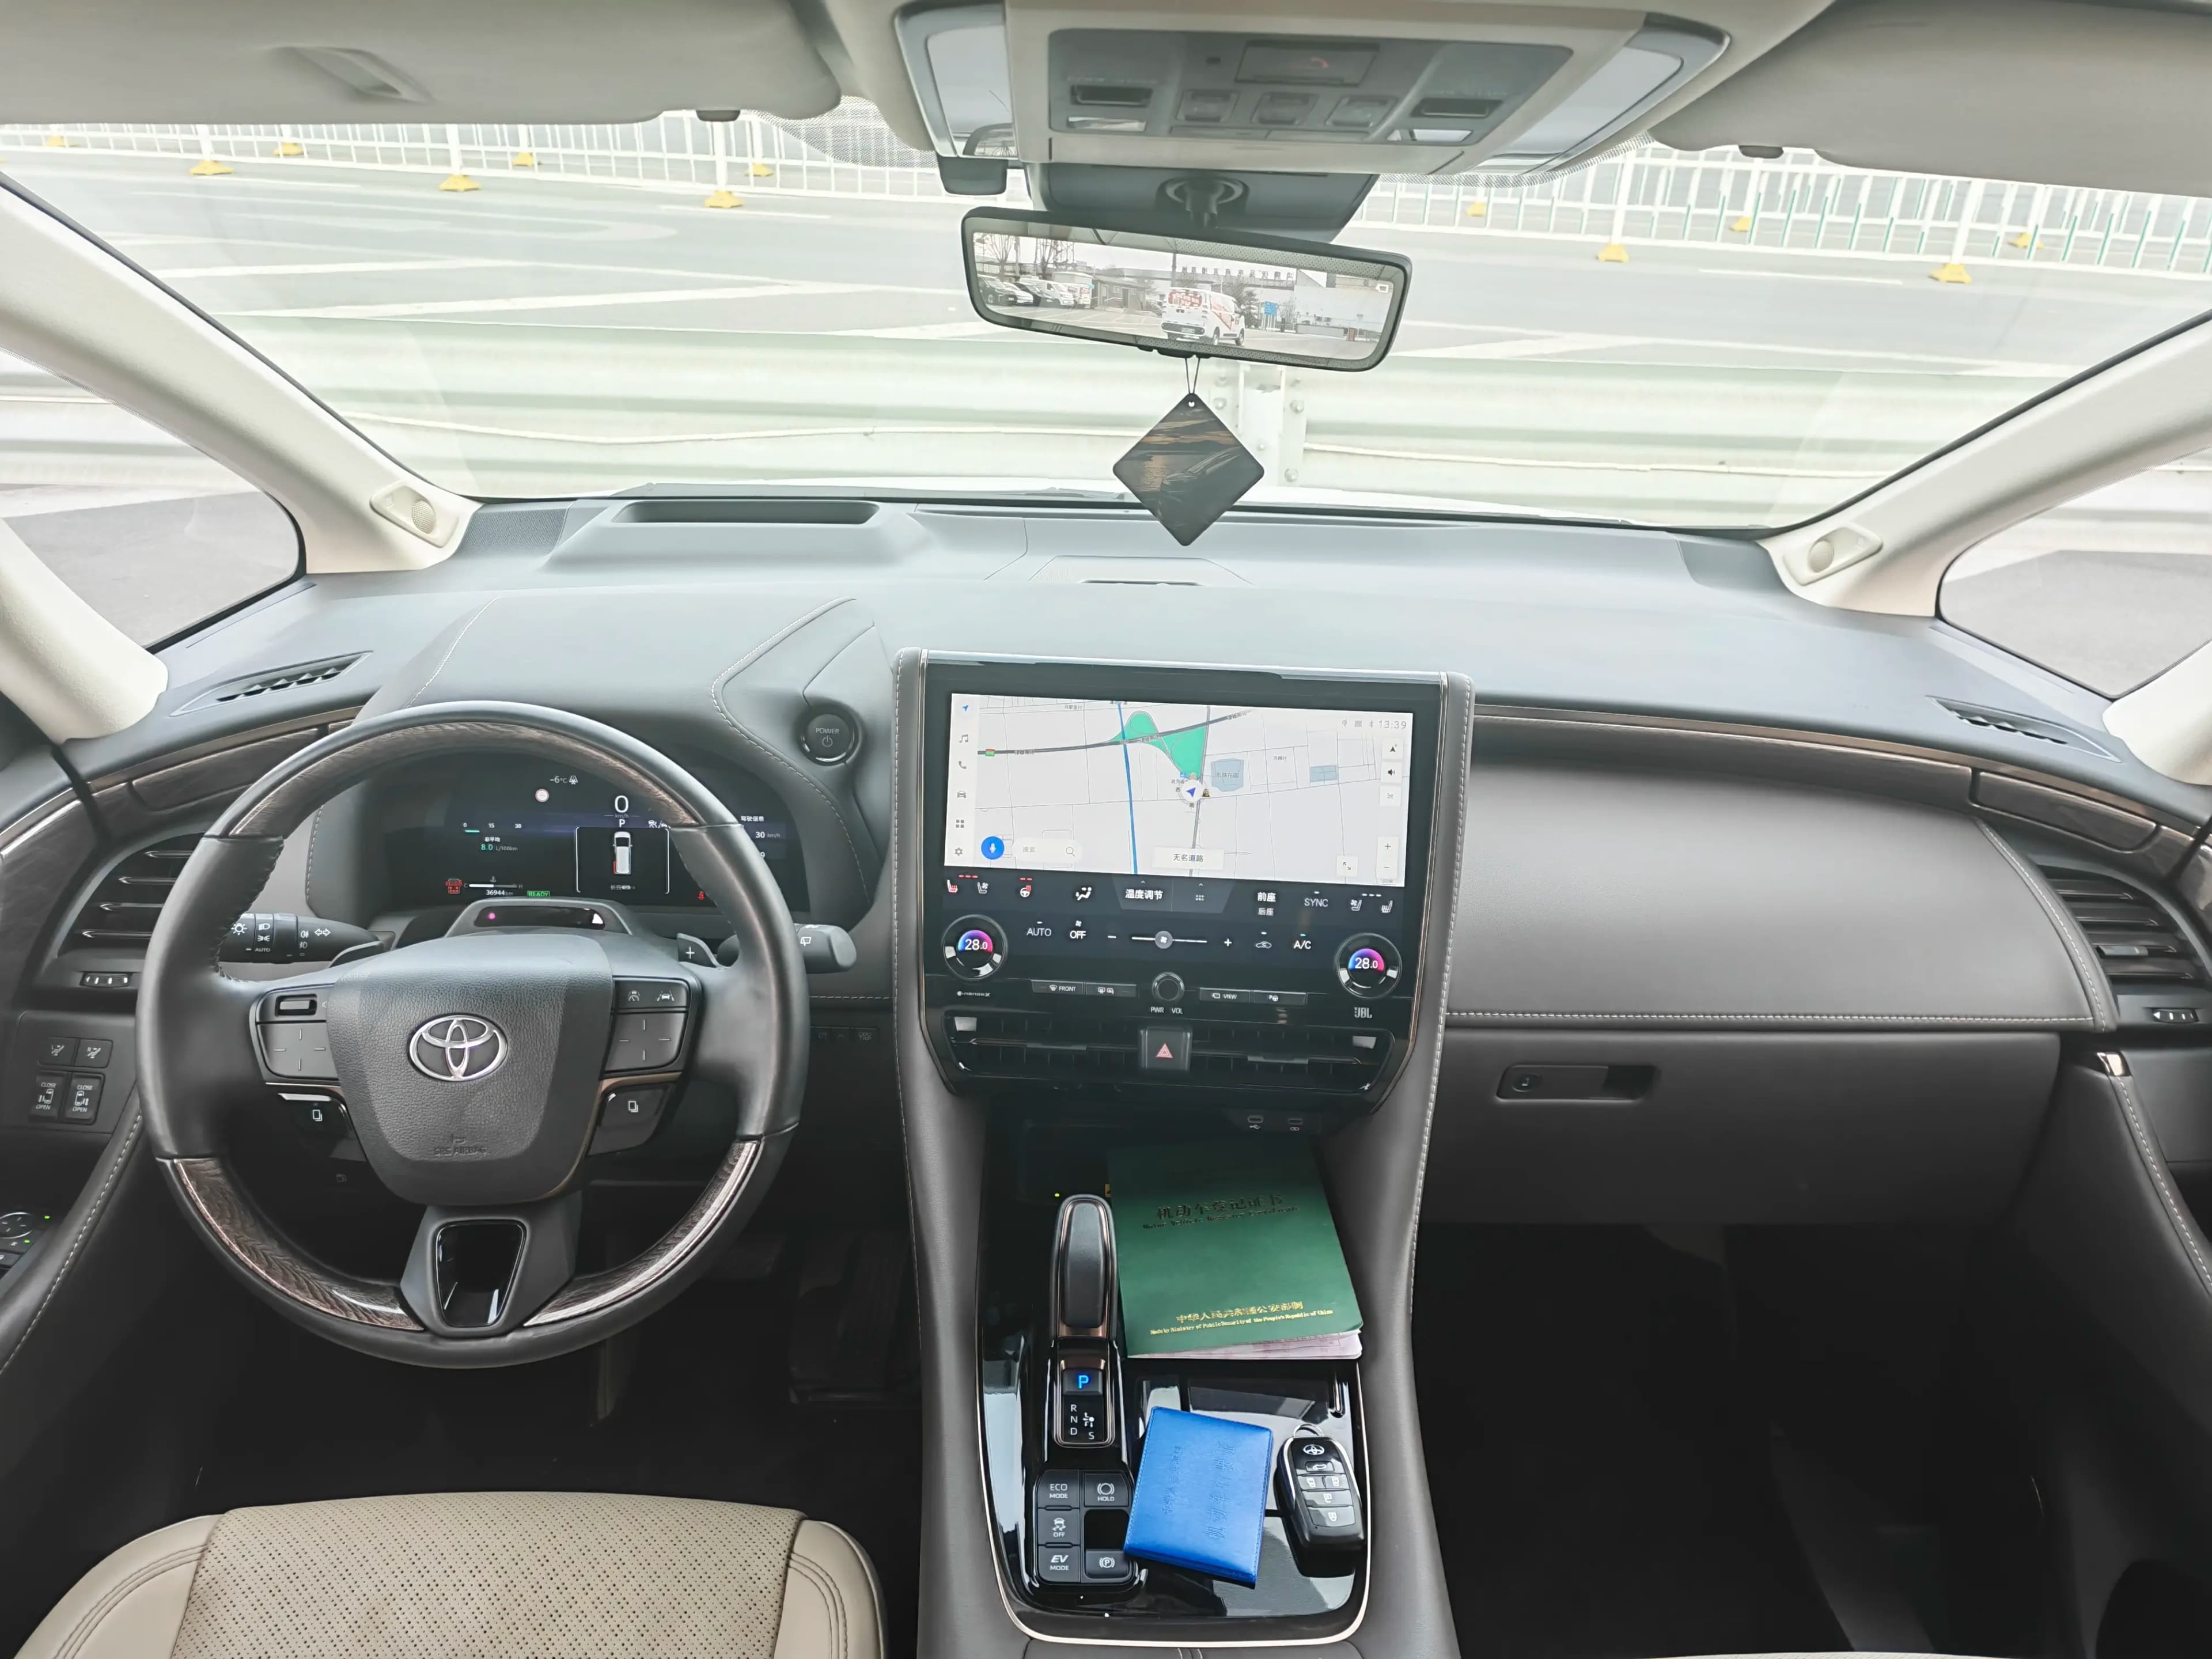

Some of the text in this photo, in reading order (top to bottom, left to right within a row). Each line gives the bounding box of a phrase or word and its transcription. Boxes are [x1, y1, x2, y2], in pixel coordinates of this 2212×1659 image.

[1378, 720, 1407, 729] 13:39
[614, 795, 629, 813] 0
[619, 819, 626, 828] P
[1173, 854, 1203, 862] 无名道路
[1125, 888, 1163, 900] 温度调节
[1257, 892, 1276, 902] 前座
[1304, 898, 1329, 907] SYNC
[1257, 907, 1274, 916] 后座
[1027, 927, 1086, 940] AUTO OFF
[964, 938, 988, 950] 28.0
[1293, 940, 1312, 950] A/C
[1354, 957, 1378, 969] 28.0
[1354, 1007, 1373, 1018] JBL
[1078, 1374, 1090, 1389] P
[1070, 1404, 1077, 1412] R
[1070, 1415, 1078, 1423] N
[1070, 1427, 1078, 1435] D
[1088, 1431, 1095, 1440] S
[1051, 1555, 1069, 1563] EV
